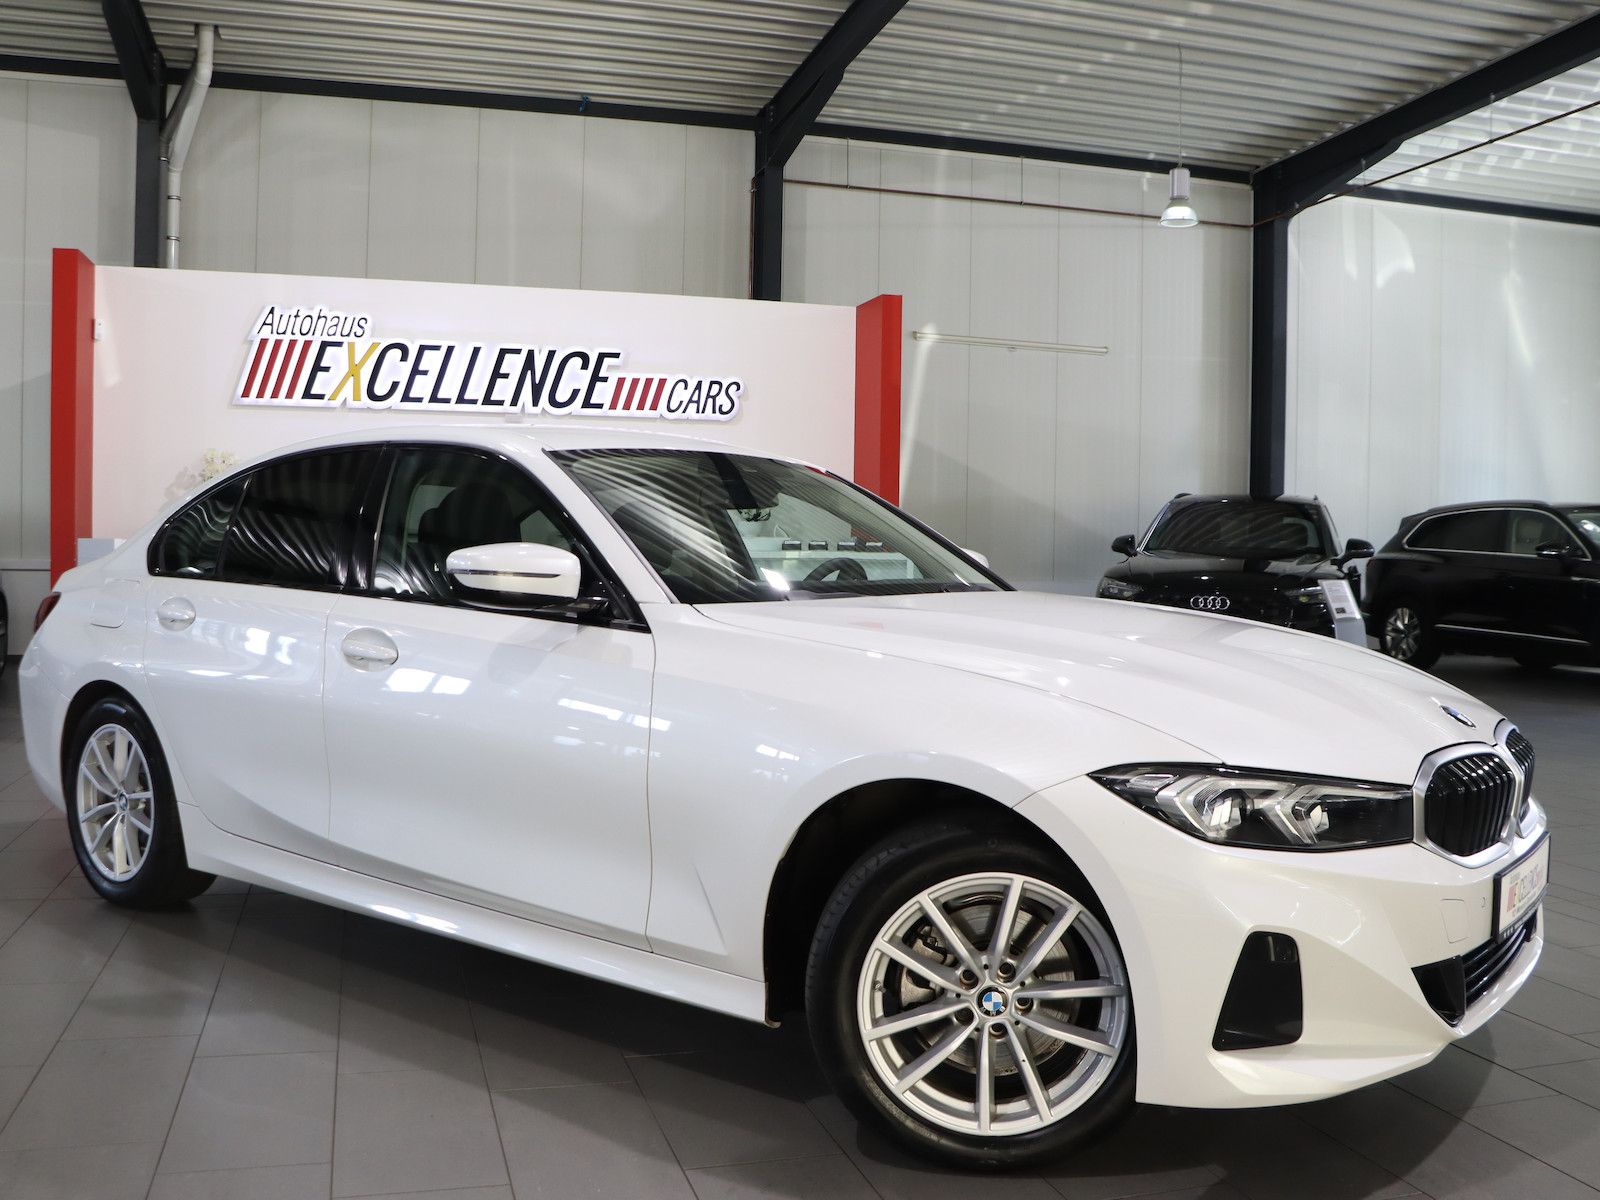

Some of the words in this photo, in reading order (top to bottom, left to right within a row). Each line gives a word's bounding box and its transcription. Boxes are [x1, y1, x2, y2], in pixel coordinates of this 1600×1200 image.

[257, 306, 368, 338] Autohaus
[301, 340, 621, 411] EXCELLENCE
[666, 378, 741, 416] CARS
